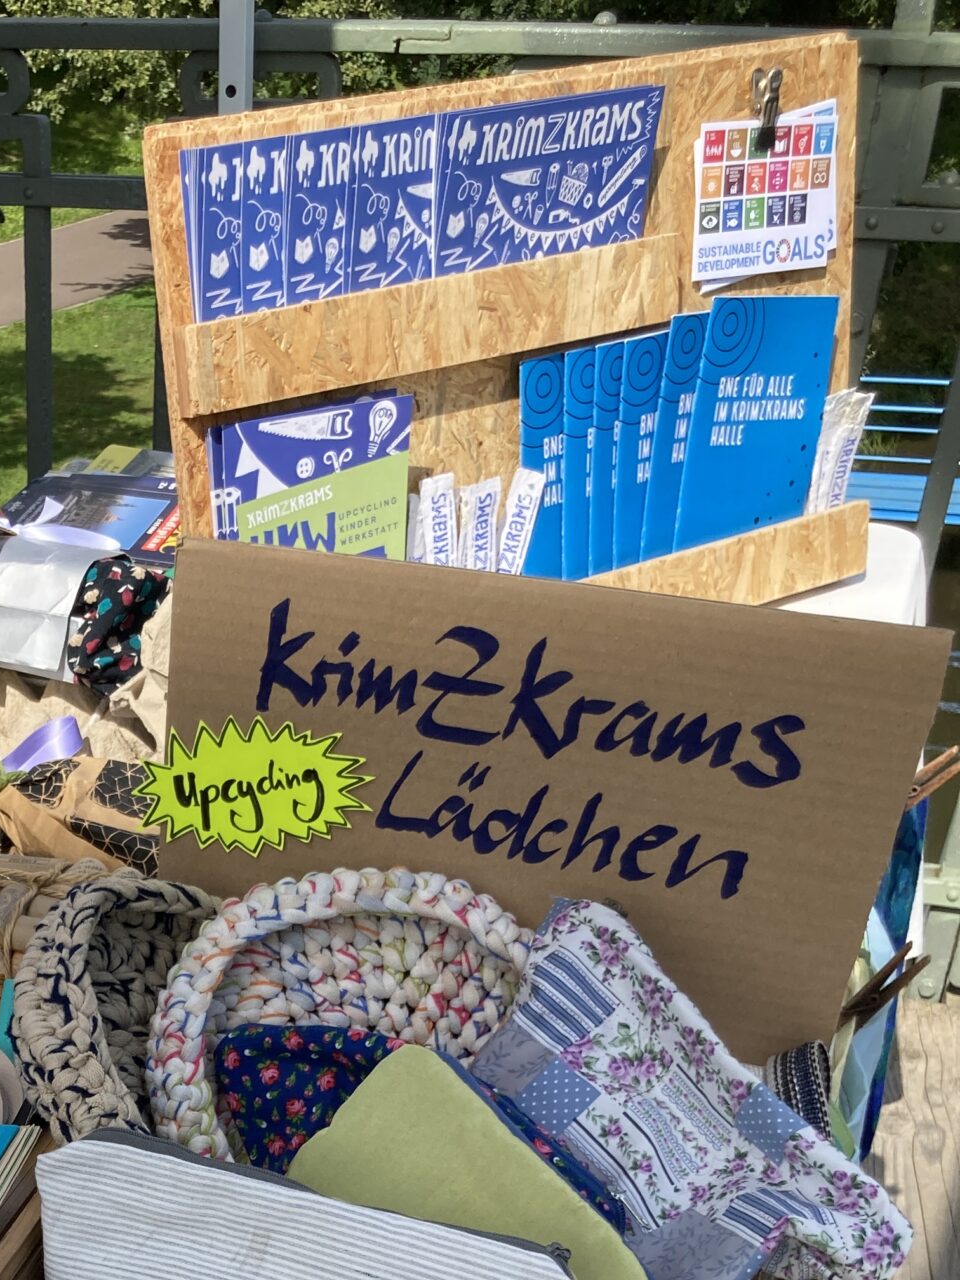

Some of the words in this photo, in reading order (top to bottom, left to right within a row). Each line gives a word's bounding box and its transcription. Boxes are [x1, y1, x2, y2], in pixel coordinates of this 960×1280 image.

[698, 241, 761, 258] SUSTAINABLE
[762, 234, 825, 265] GOALS
[697, 255, 761, 273] DEVELOPMENT
[718, 377, 739, 398] BNE
[743, 373, 763, 398] FÜR
[766, 375, 794, 397] ALLE
[714, 402, 729, 423] IM
[731, 399, 805, 422] KRIMZKRAMS
[674, 417, 688, 440] IM
[710, 424, 744, 446] HALLE
[638, 437, 651, 460] IM
[338, 496, 398, 521] UPCYCLING
[339, 516, 378, 533] KINDER
[340, 522, 399, 546] WERKSTATT
[374, 750, 750, 900] Lädchen
